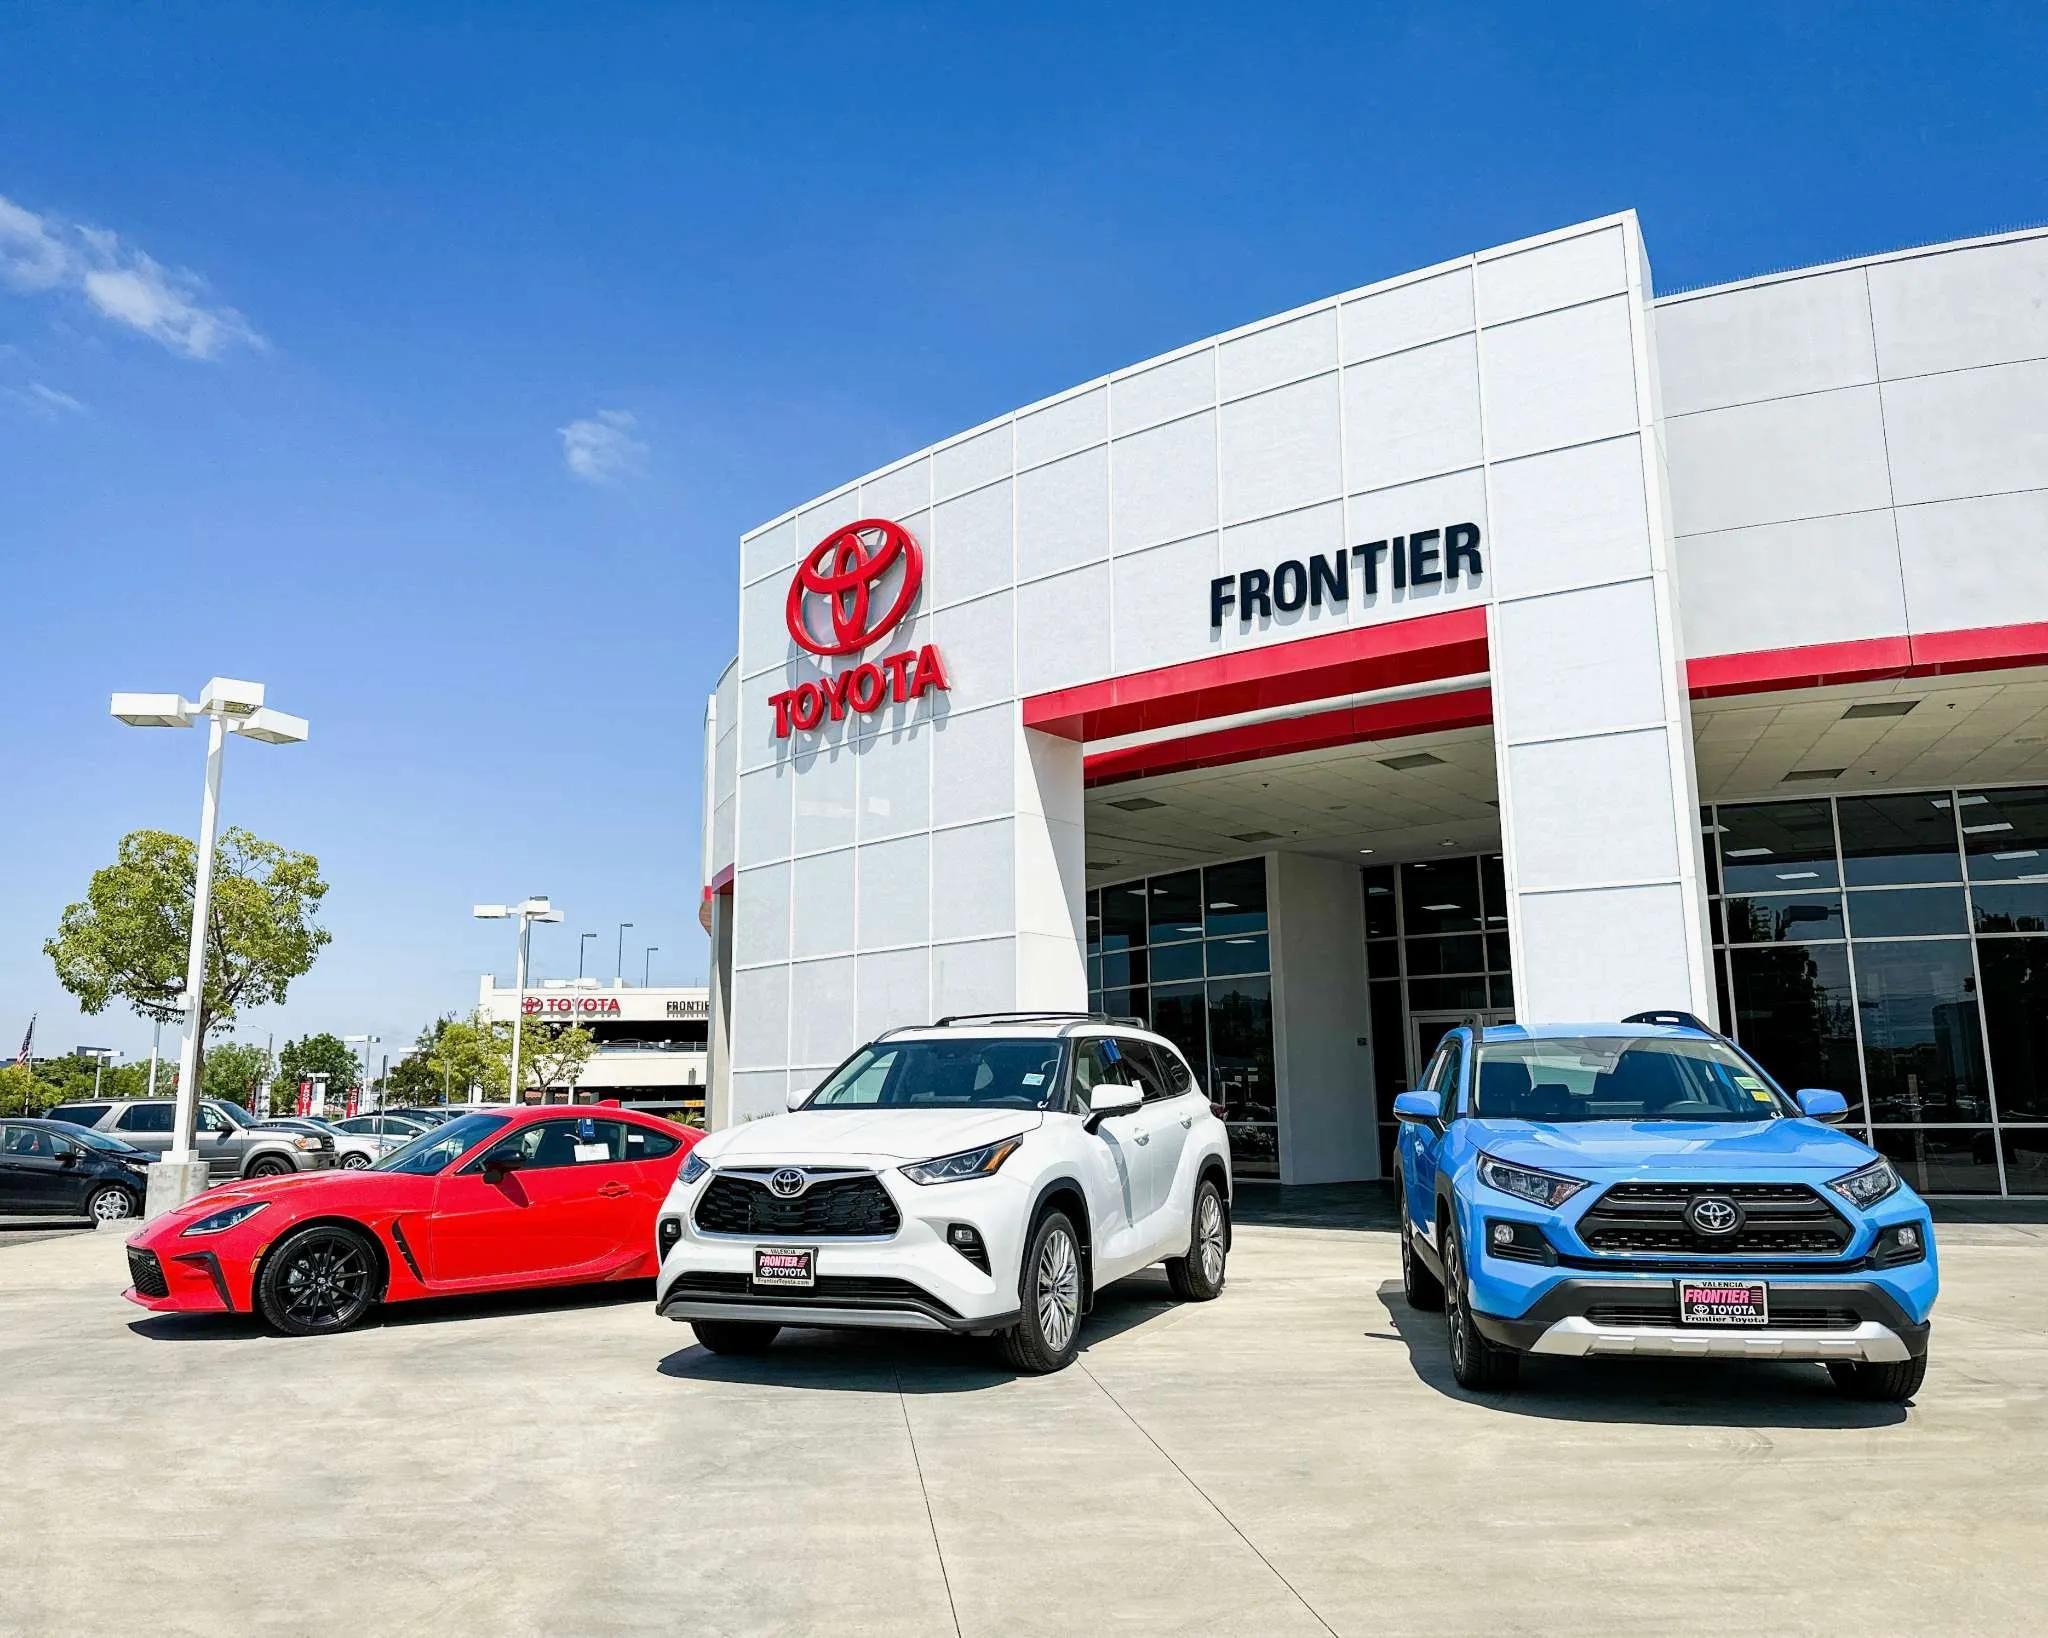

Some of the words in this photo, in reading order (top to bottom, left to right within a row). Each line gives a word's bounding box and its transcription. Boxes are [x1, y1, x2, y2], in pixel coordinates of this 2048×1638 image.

[1210, 522, 1483, 628] FRONTIER
[768, 644, 951, 738] TOYOTA
[547, 999, 621, 1012] TOYOTA
[760, 1256, 798, 1267] FRONTIER
[772, 1268, 807, 1277] TOYOTA
[758, 1278, 810, 1286] FrontierToyota.com
[1684, 1289, 1750, 1303] FRONTIER
[1711, 1305, 1756, 1315] TOYOTA
[1686, 1315, 1727, 1323] Frontier
[1731, 1316, 1765, 1324] Toyota
